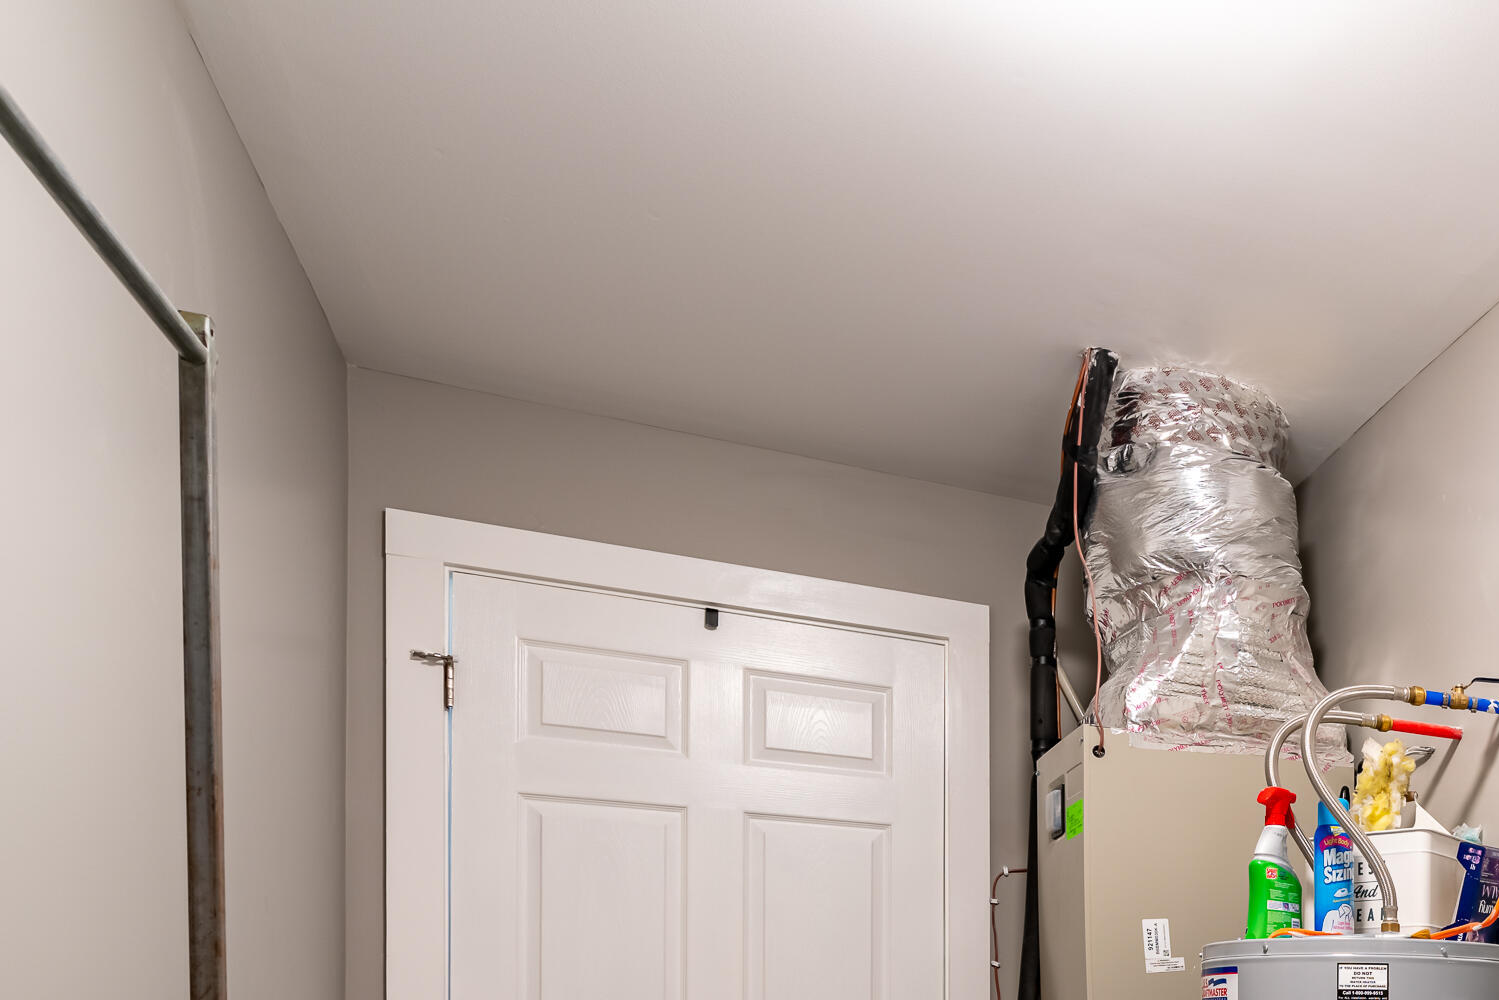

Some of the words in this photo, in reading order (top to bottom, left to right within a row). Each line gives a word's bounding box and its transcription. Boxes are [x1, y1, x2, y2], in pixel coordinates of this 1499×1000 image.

[1323, 848, 1353, 867] Mag
[1323, 866, 1352, 884] Sizin
[1146, 928, 1154, 951] 921147
